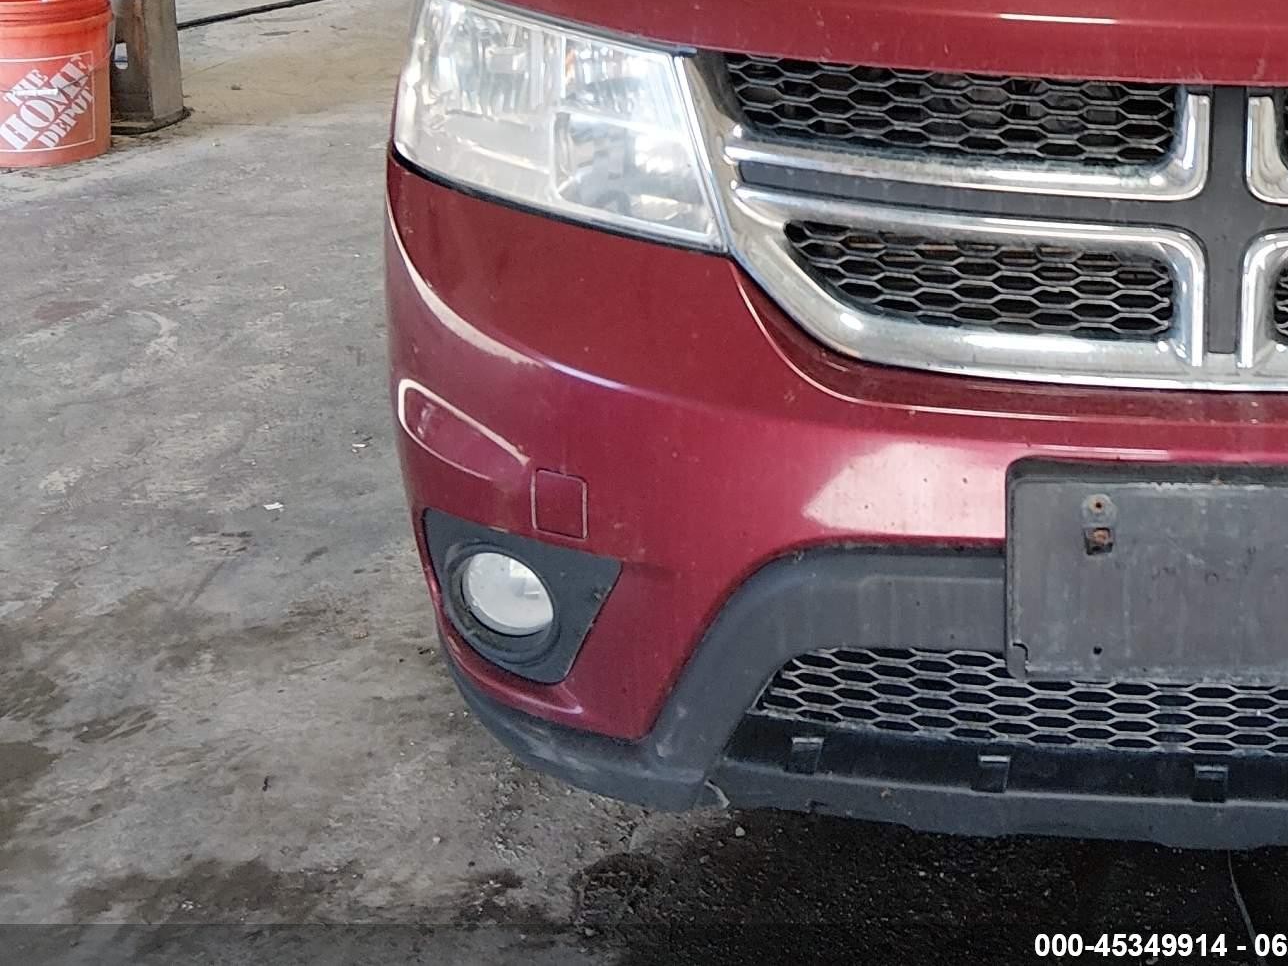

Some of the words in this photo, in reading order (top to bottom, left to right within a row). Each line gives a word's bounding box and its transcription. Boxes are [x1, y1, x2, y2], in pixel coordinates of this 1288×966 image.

[0, 54, 95, 151] HOME
[3, 69, 48, 107] THE
[38, 85, 95, 149] DEPOT
